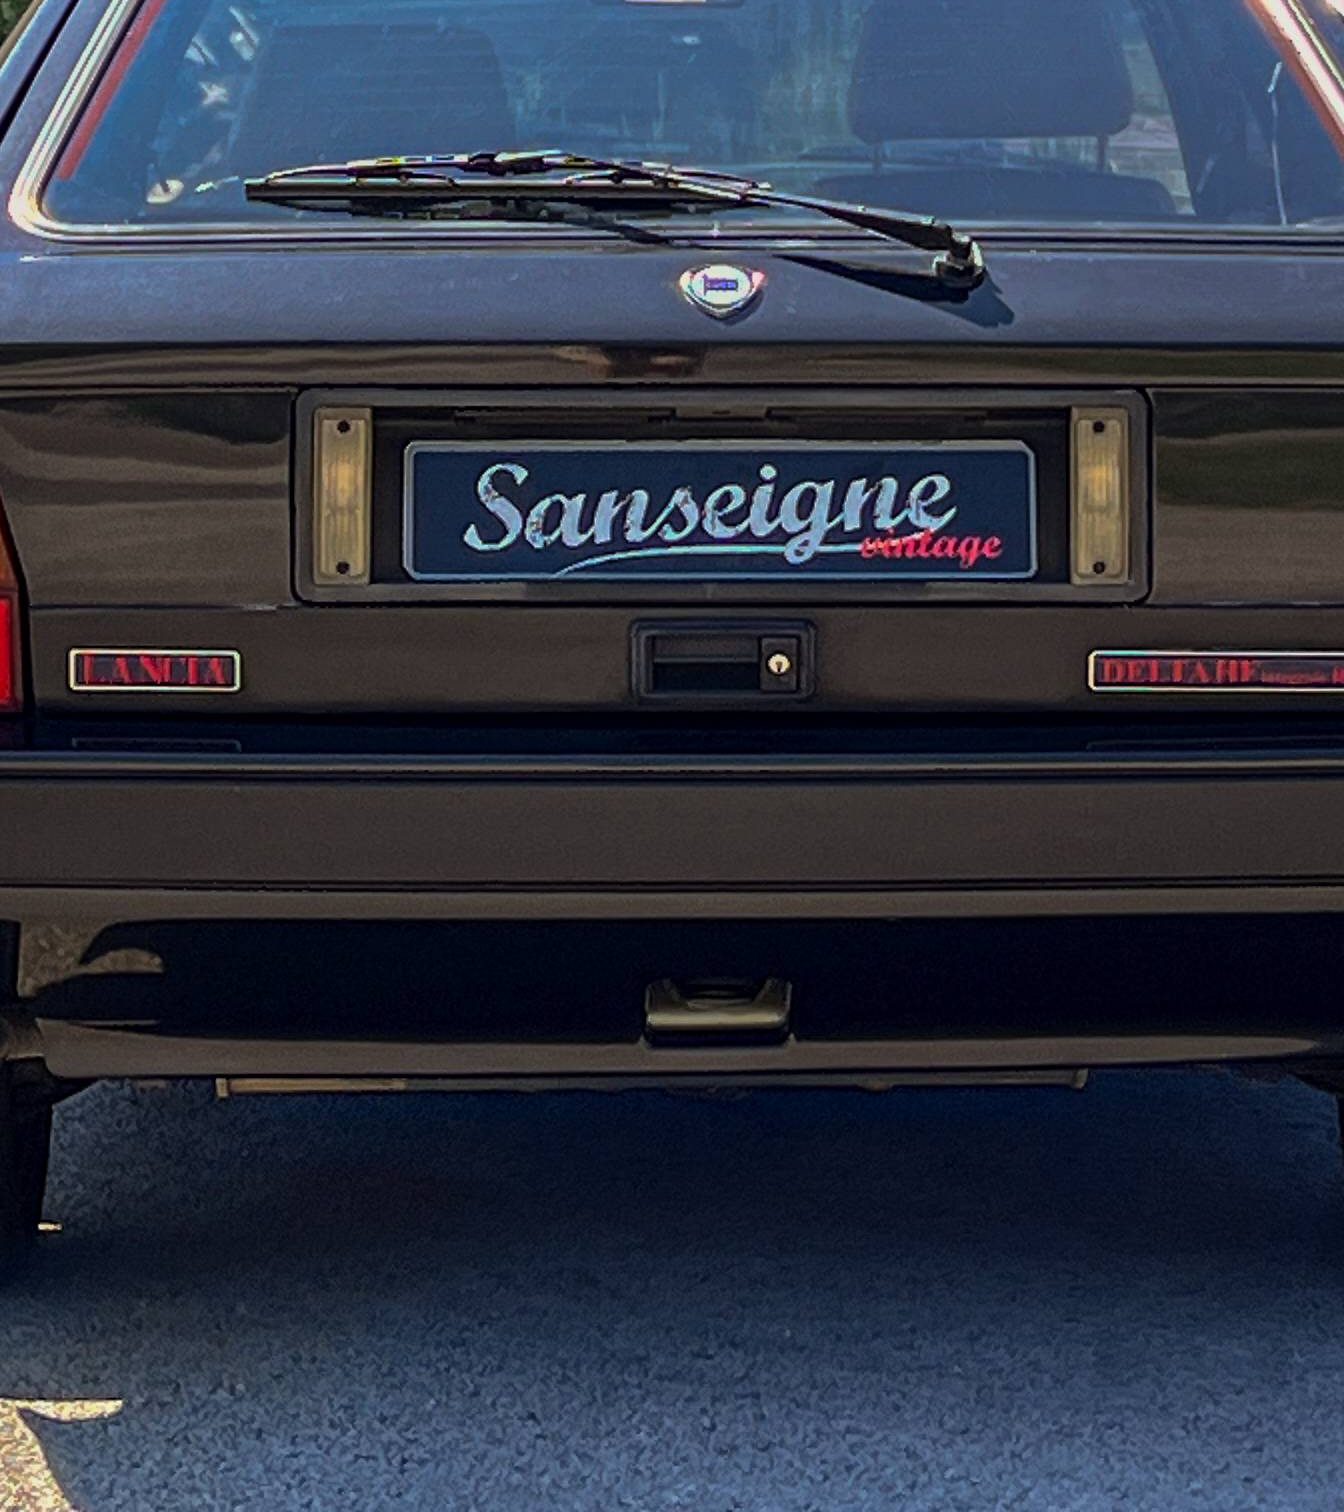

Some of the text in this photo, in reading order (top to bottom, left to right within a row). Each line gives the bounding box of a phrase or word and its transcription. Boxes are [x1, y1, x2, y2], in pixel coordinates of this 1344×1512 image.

[463, 463, 957, 565] Sanseigne
[859, 526, 1003, 568] vintage
[81, 655, 227, 685] LANCIA
